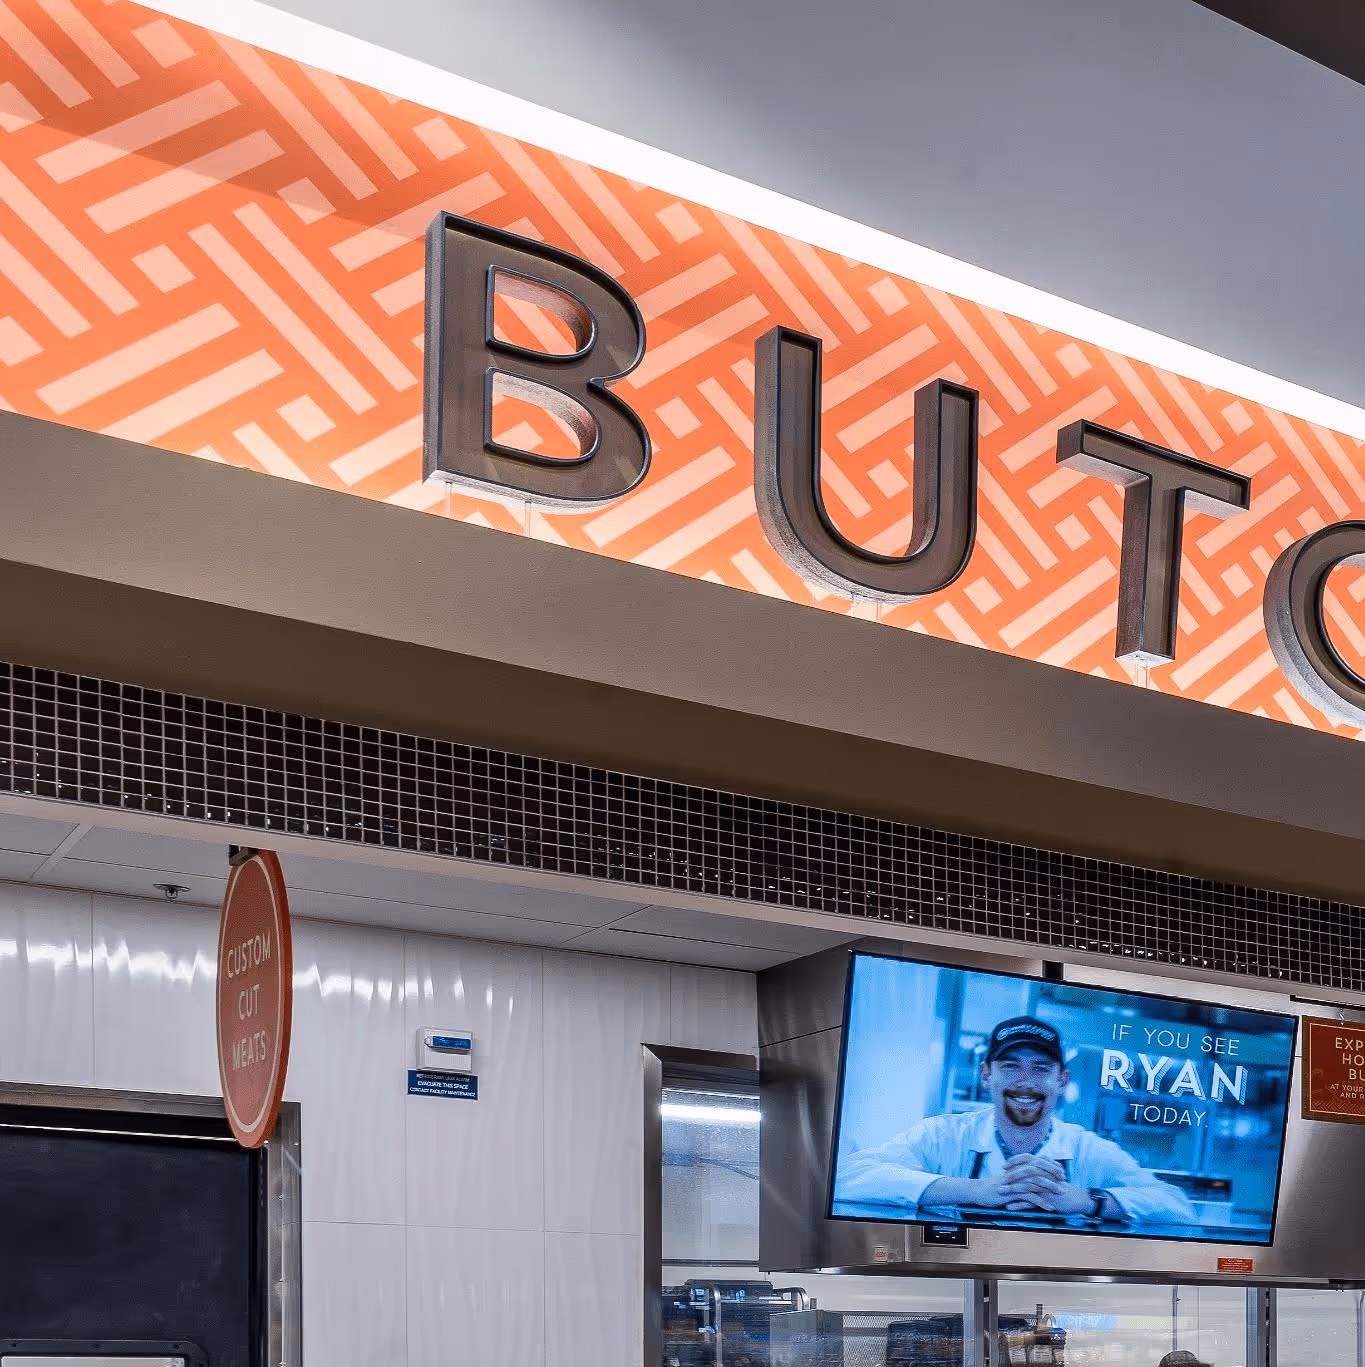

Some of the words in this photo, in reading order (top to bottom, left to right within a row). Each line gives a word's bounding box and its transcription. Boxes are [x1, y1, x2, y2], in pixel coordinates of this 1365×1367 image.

[227, 932, 271, 978] CUSTOM
[238, 983, 260, 1021] CUT
[232, 1030, 266, 1071] MEATS
[1112, 1023, 1132, 1041] IF
[1144, 1027, 1190, 1050] YOU
[1200, 1035, 1240, 1056] SEE
[1100, 1048, 1248, 1105] RYAN
[1342, 1084, 1363, 1093] YOUR
[1340, 1091, 1357, 1099] AND
[1129, 1103, 1208, 1128] TODAY.
